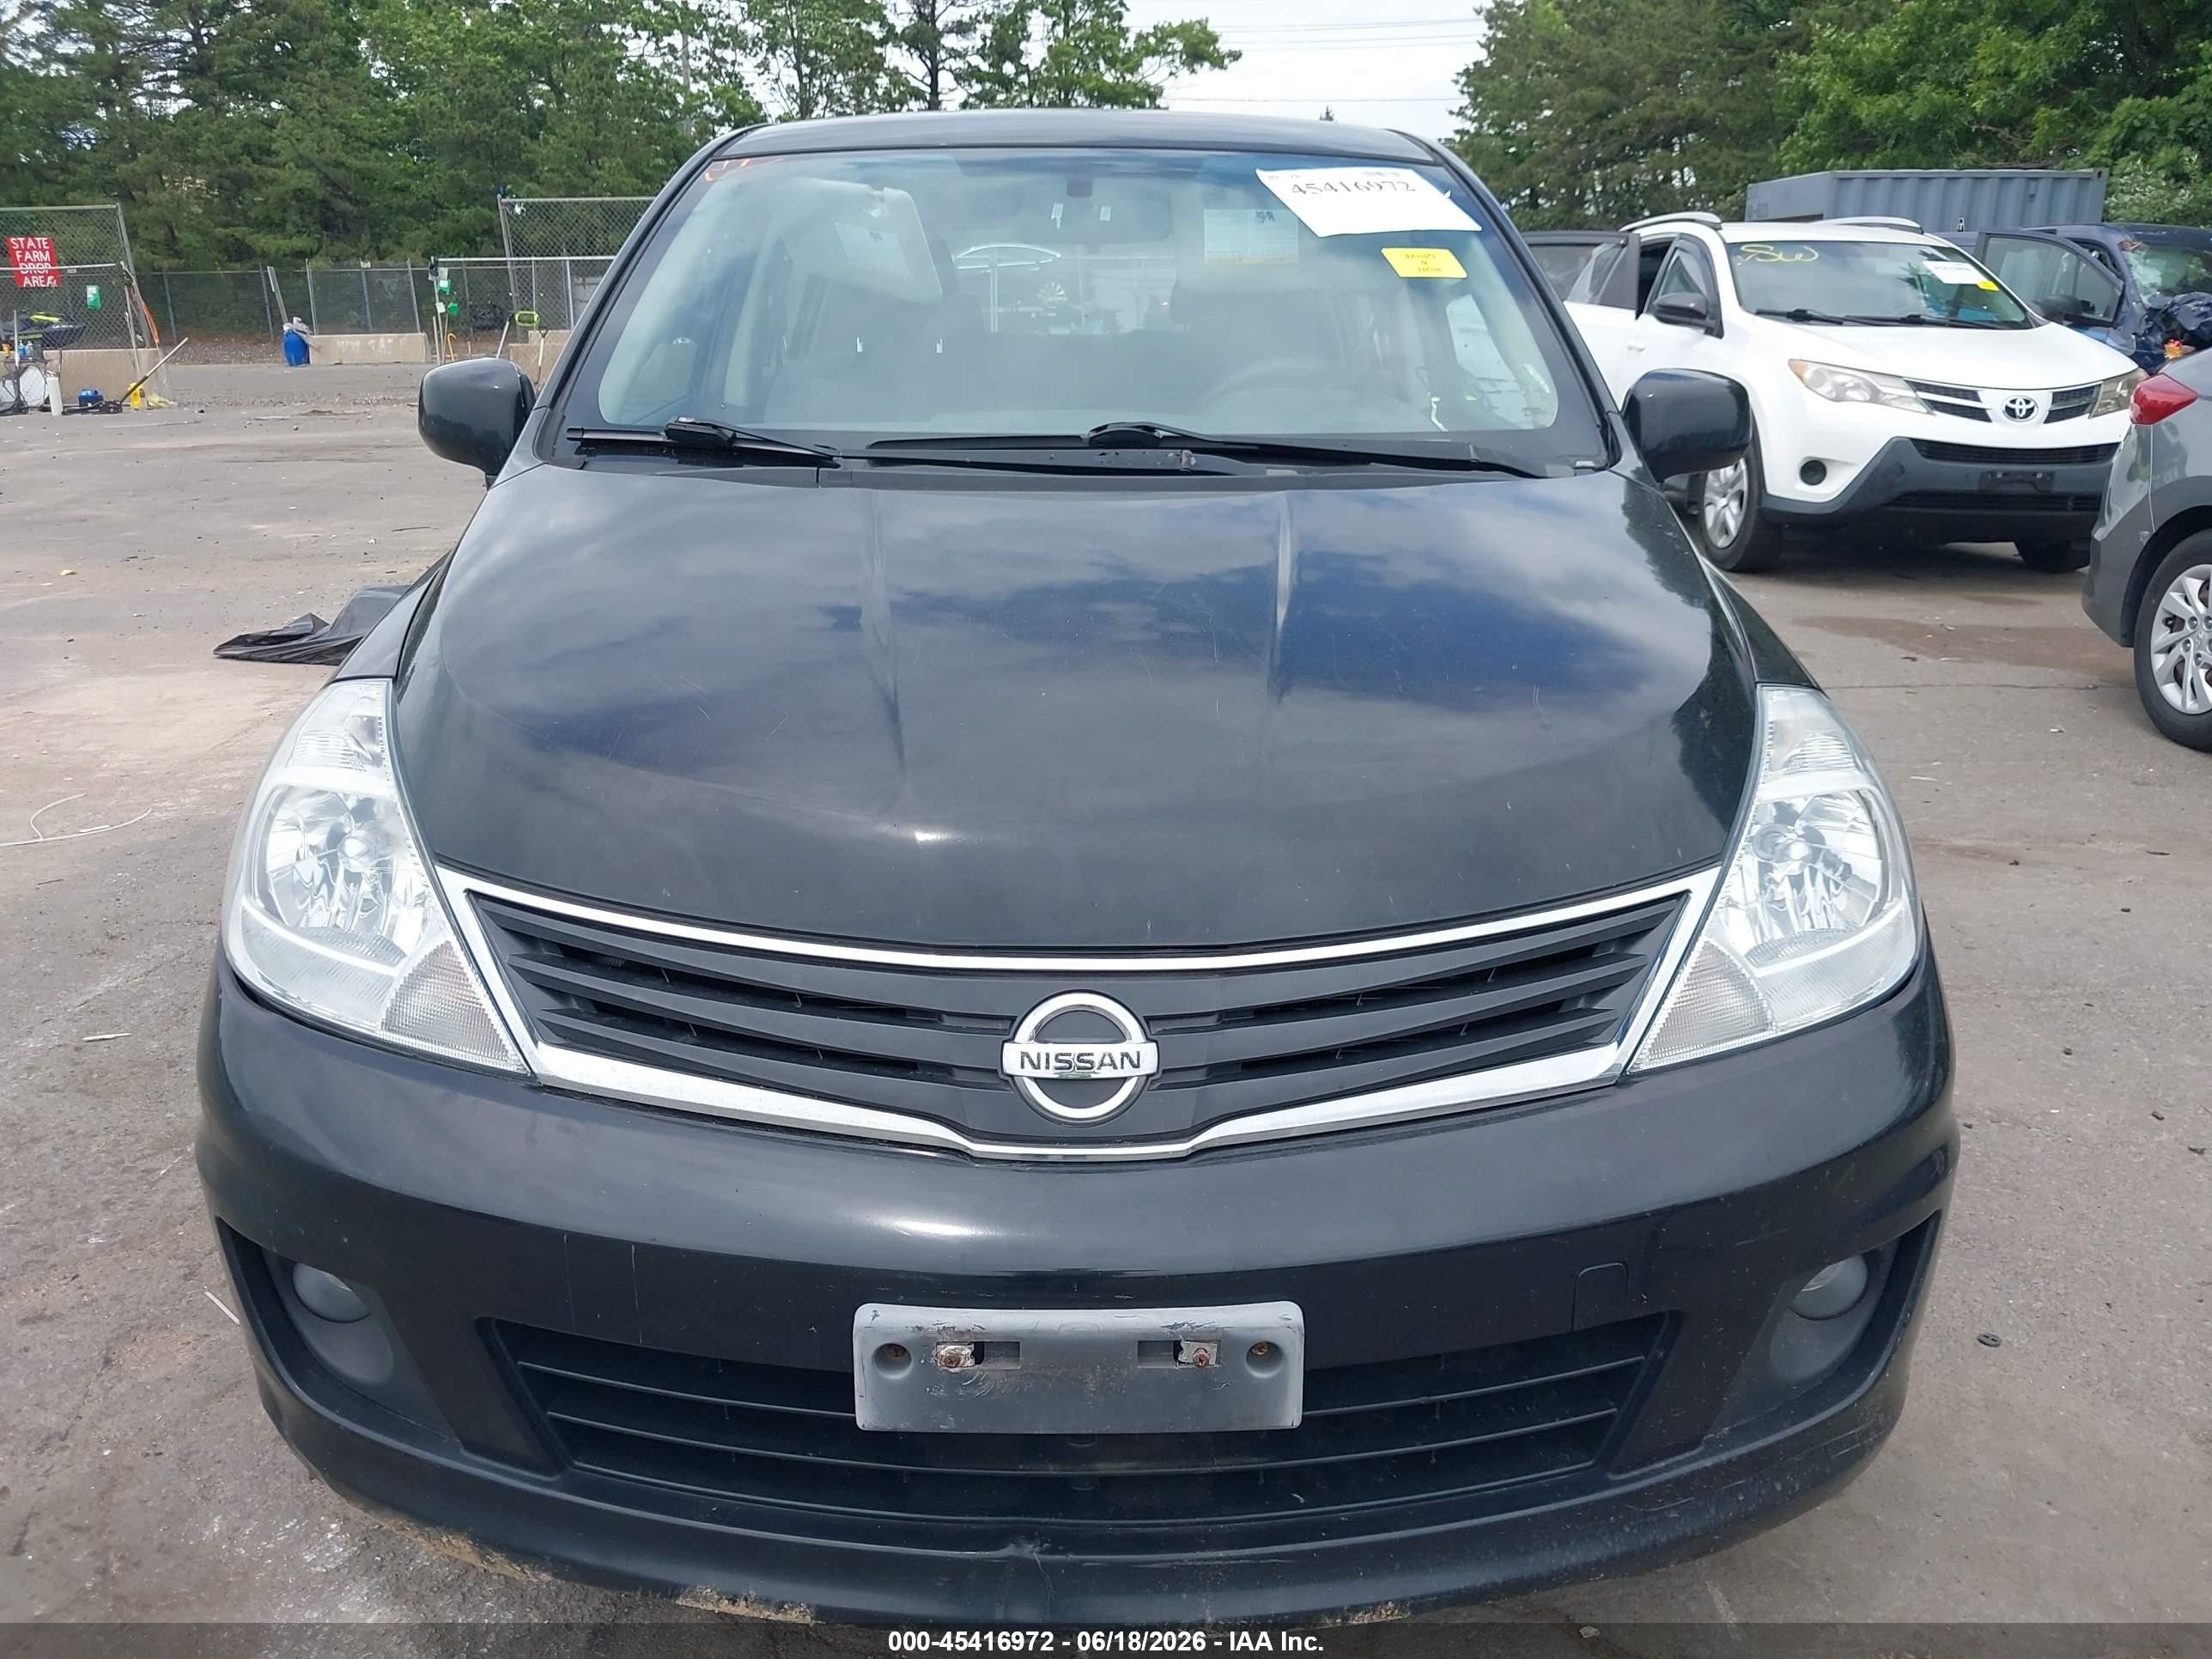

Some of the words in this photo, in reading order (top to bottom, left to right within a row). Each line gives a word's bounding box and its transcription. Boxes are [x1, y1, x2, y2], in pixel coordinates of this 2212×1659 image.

[1291, 180, 1416, 195] 45416972
[10, 237, 50, 249] STATE
[15, 250, 51, 262] FARM
[19, 262, 52, 274] DROP
[23, 275, 58, 288] AREA
[1019, 1050, 1141, 1071] NISSAN
